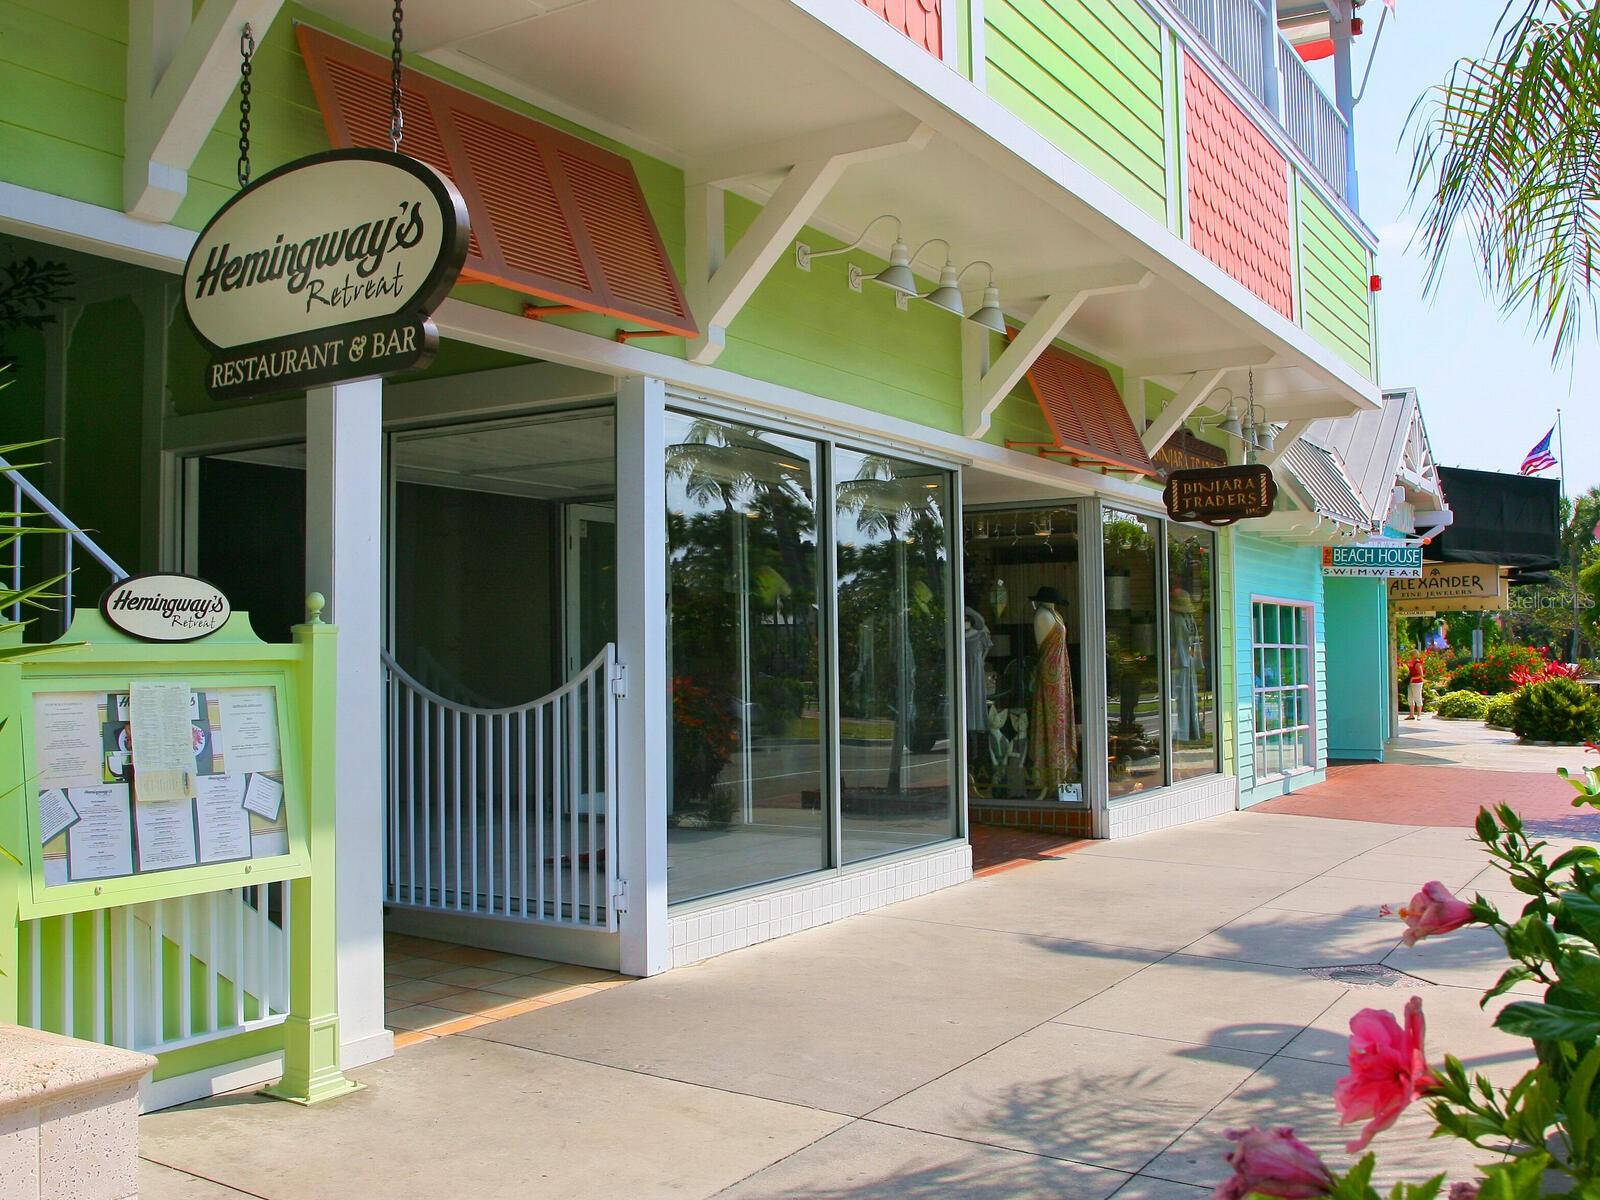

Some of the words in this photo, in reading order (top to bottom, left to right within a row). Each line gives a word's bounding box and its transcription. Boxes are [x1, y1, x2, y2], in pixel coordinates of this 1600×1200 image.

[195, 201, 424, 299] Hemingway's
[306, 261, 404, 313] Retreat
[211, 339, 344, 389] RESTAURANT
[348, 335, 367, 363] &
[371, 326, 417, 358] BAR
[1183, 492, 1256, 509] TRADERS
[1333, 548, 1374, 563] BEACH
[1378, 549, 1420, 564] HOUSE
[1390, 575, 1484, 595] ALEXANDER
[1427, 590, 1474, 598] JEWELERS
[112, 590, 224, 618] Hemingway's
[171, 614, 217, 628] Retreat
